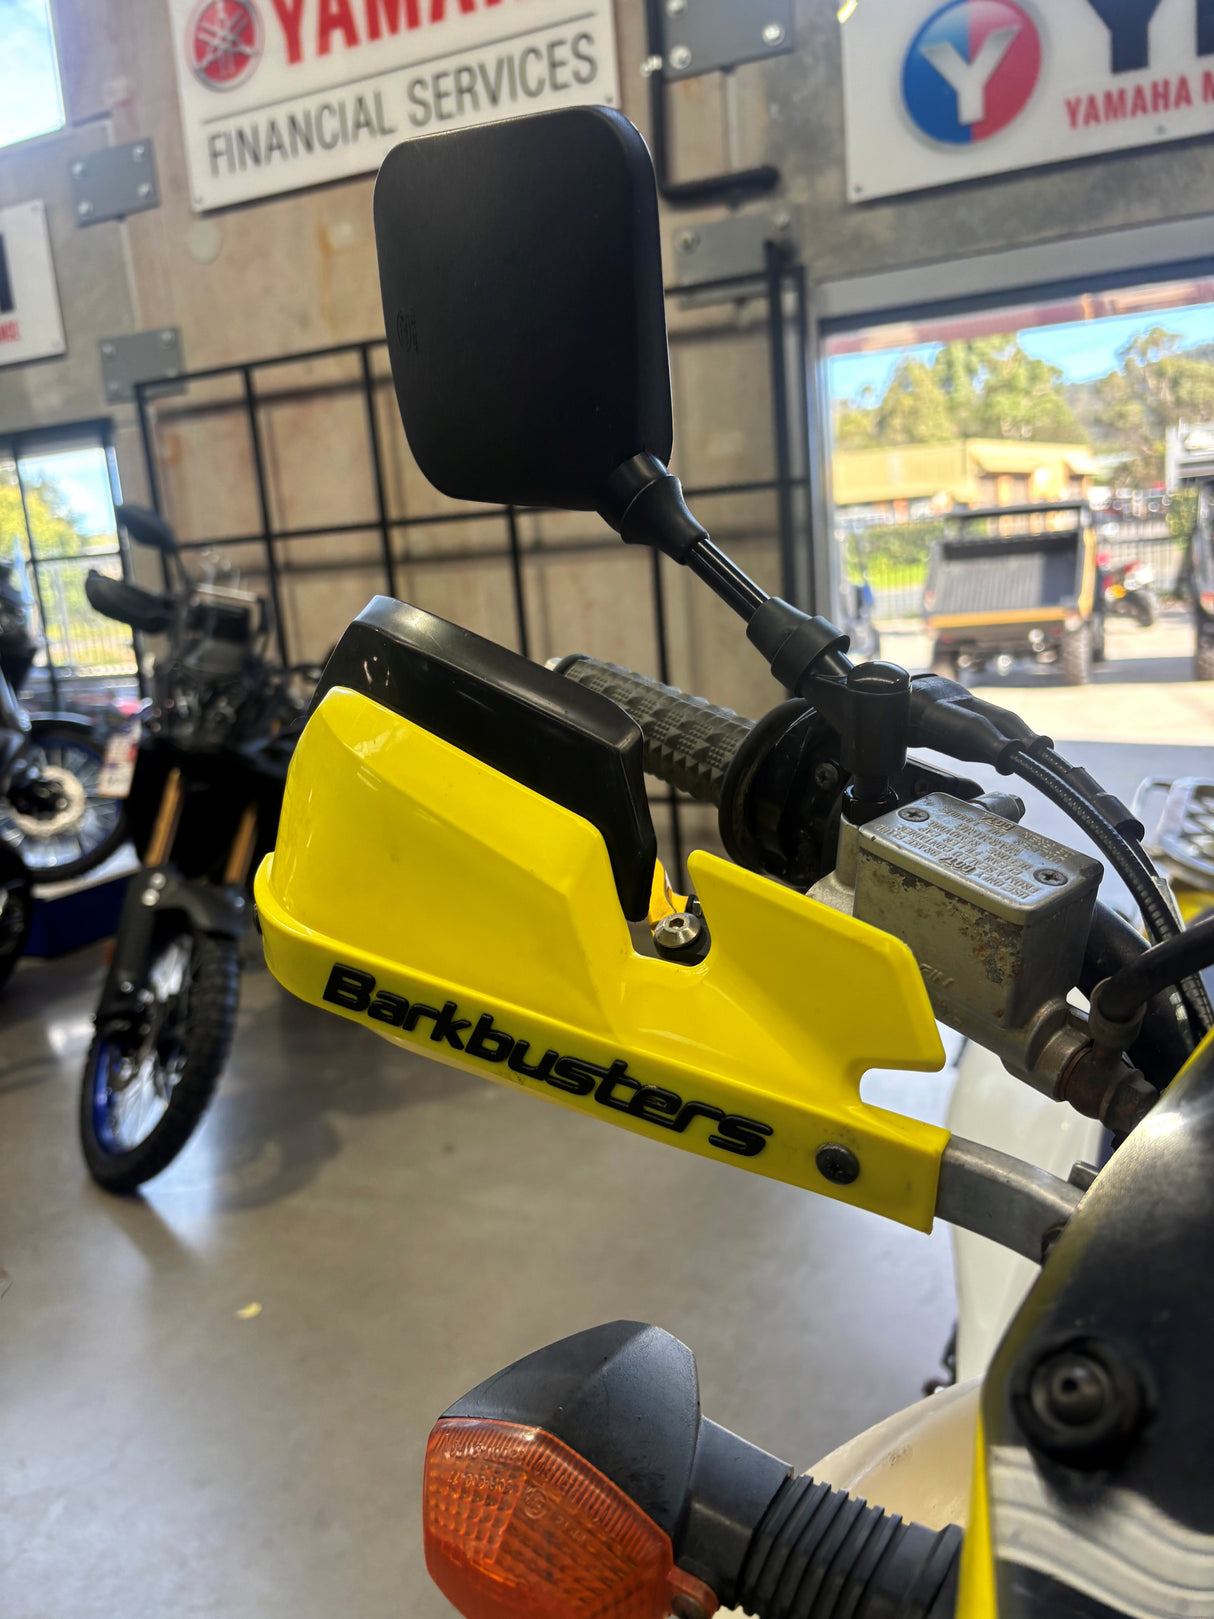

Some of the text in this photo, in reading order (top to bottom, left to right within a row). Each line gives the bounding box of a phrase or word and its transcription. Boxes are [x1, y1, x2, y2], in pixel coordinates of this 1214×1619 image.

[918, 24, 1021, 126] Y
[208, 32, 599, 178] FINANCIAL SERVICES
[1065, 74, 1193, 130] YAMAHA
[901, 837, 942, 857] BRAKE
[916, 826, 1023, 876] CLEAN FILLER CAP
[949, 850, 998, 873] SEALED
[972, 871, 1006, 888] ONLY
[999, 884, 1031, 899] USE
[1001, 873, 1042, 893] FROM
[322, 961, 773, 1157] Barkbusters
